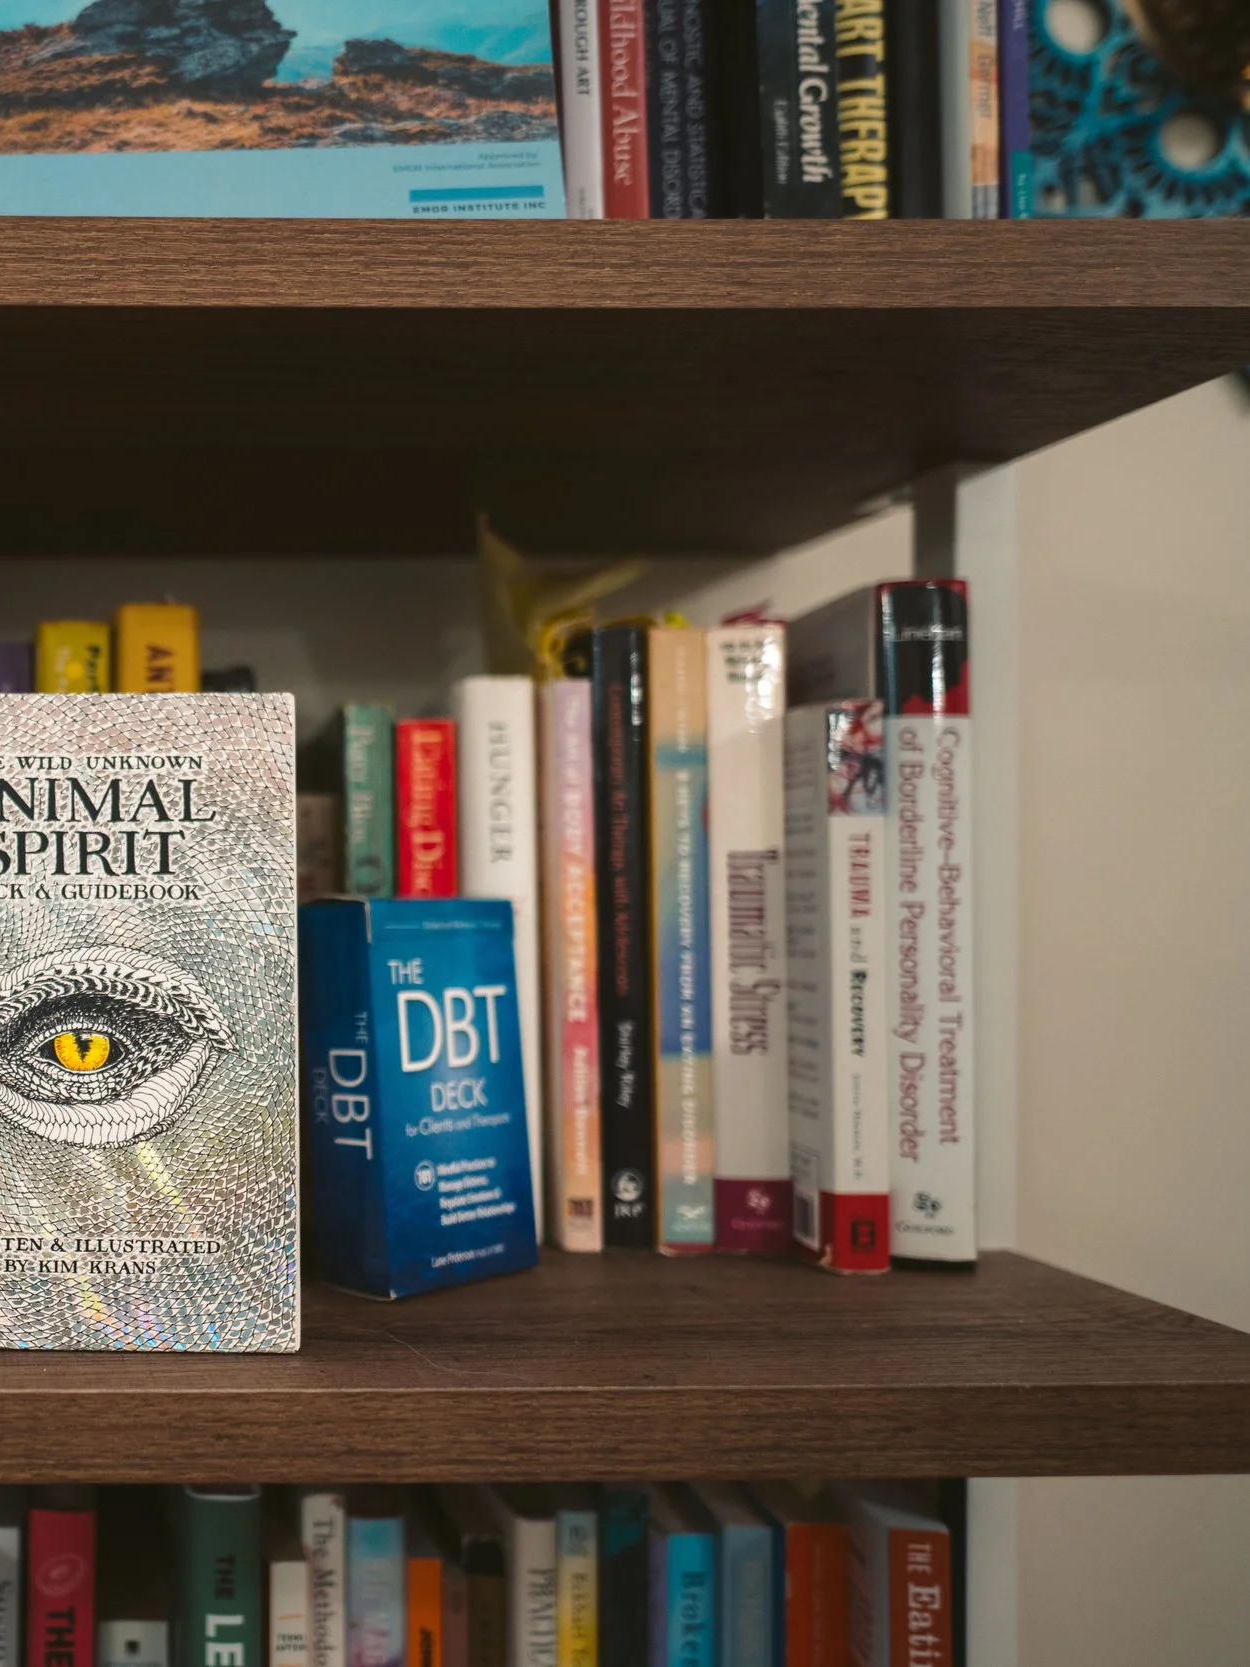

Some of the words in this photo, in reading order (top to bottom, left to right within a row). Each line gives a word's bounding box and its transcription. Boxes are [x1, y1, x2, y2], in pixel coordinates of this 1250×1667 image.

[836, 0, 886, 61] ART
[575, 65, 591, 97] ART
[611, 103, 641, 187] Abuse
[799, 78, 834, 184] Growth
[453, 202, 520, 212] INSTITUTE
[524, 201, 547, 210] INC
[146, 645, 175, 692] AN
[16, 755, 73, 770] WILD
[86, 755, 204, 770] UNKNOWN
[899, 727, 925, 755] of
[488, 720, 516, 864] HUNGER
[563, 792, 584, 857] BODY
[898, 760, 925, 894] Borderline
[35, 883, 51, 900] &
[61, 883, 202, 901] GUIDEBOOK
[848, 830, 872, 920] TRAUMA
[930, 726, 962, 1003] Cognitive-Behavioral
[726, 848, 781, 974] Traumatic
[387, 957, 425, 985] THE
[565, 862, 588, 1024] ACCEPTANCE
[892, 901, 926, 1045] Personality
[353, 1011, 368, 1044] THE
[396, 984, 508, 1073] DBT
[729, 977, 788, 1056] Stress
[850, 969, 869, 1058] RECOVERY
[310, 1066, 329, 1124] DECK
[328, 1048, 373, 1160] DBT
[430, 1077, 489, 1113] DECK
[898, 1052, 925, 1163] Disorder
[937, 1012, 963, 1145] Treatment
[4, 1258, 31, 1274] BY
[38, 1258, 79, 1274] KIM
[90, 1260, 157, 1275] KRANS
[49, 1238, 67, 1252] &
[75, 1238, 221, 1254] ILLUSTRATED
[312, 1516, 337, 1559] The
[906, 1542, 933, 1576] THE
[214, 1553, 237, 1600] THE
